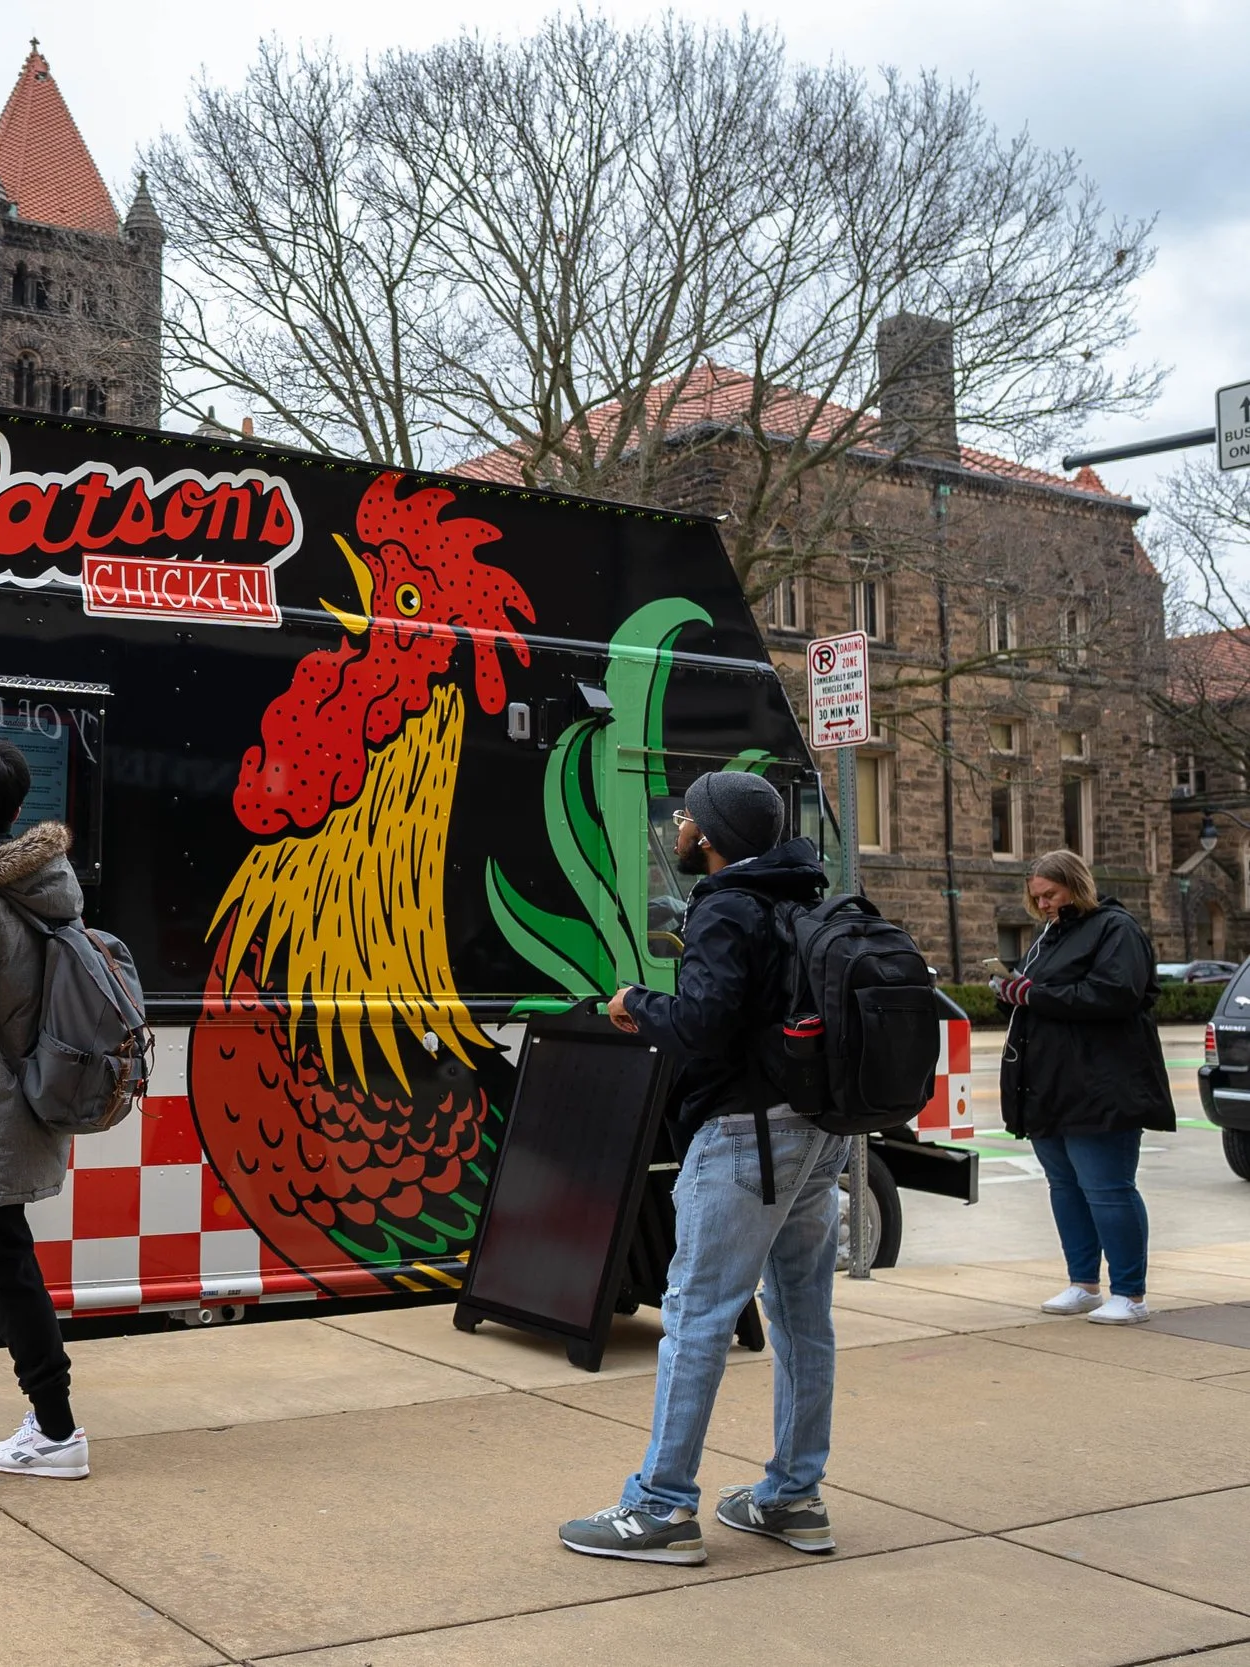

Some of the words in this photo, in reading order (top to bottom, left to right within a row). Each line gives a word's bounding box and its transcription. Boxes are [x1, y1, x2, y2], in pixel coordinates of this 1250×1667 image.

[1225, 427, 1250, 442] BUS
[91, 562, 265, 612] CHICKEN
[836, 640, 862, 655] LOADING
[842, 656, 858, 669] ZONE
[814, 673, 846, 686] COMMERCIALLY
[847, 670, 862, 680] SIGNED
[822, 684, 842, 694] VEHICLES
[843, 683, 854, 691] ONLY
[815, 696, 835, 708] ACTIVE
[837, 691, 863, 704] LOADING
[819, 710, 828, 720] 30
[830, 707, 843, 719] MIN
[846, 705, 860, 715] MAX
[817, 731, 846, 742] TOW-AWAY
[848, 728, 862, 739] ZONE
[1219, 1024, 1247, 1032] MARINER
[748, 1504, 765, 1525] N
[611, 1516, 645, 1539] N
